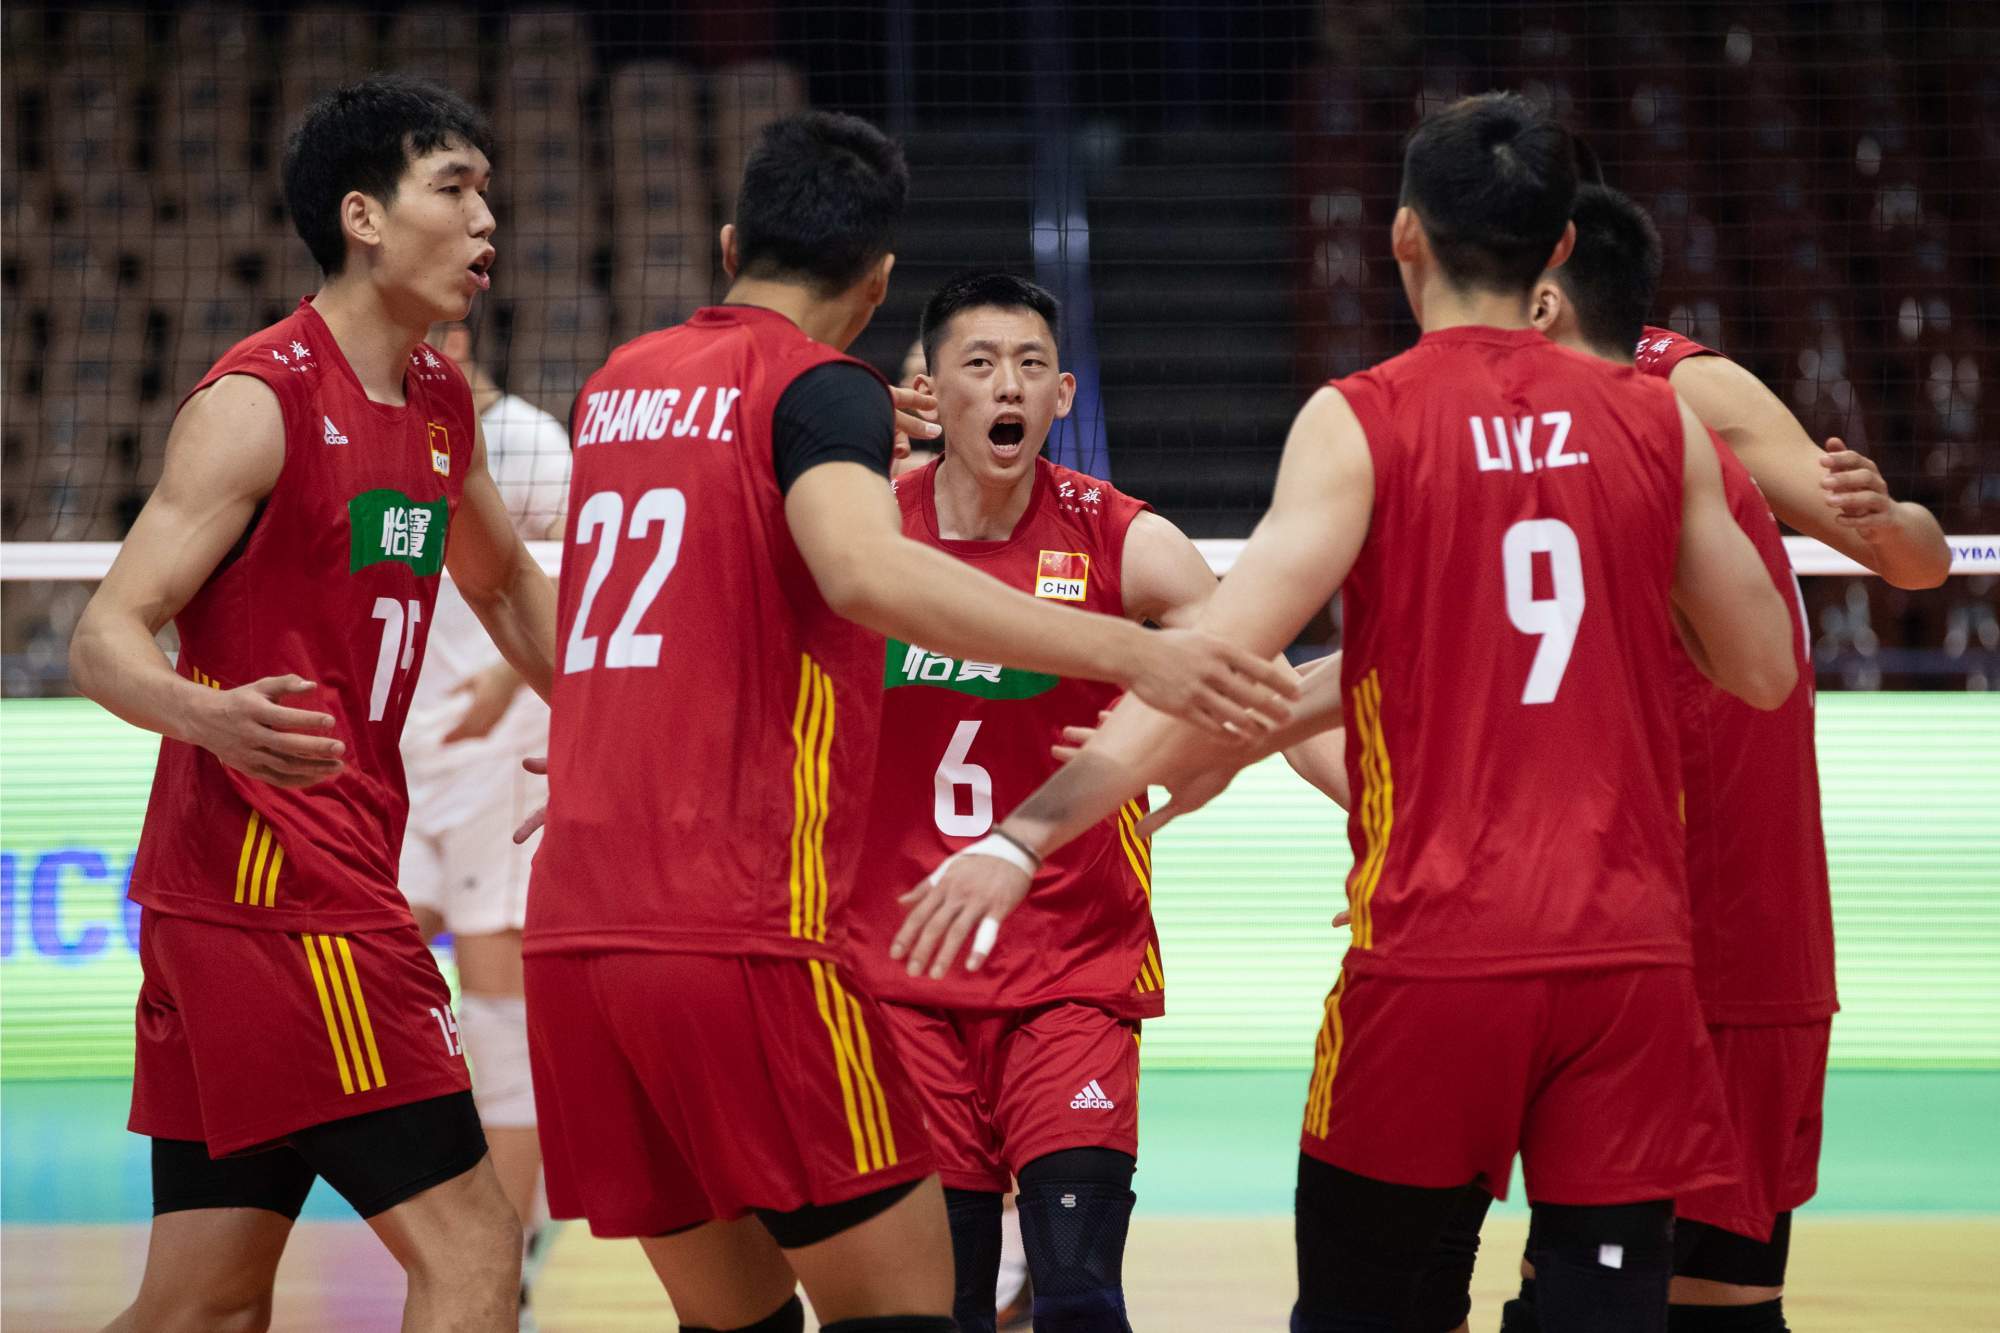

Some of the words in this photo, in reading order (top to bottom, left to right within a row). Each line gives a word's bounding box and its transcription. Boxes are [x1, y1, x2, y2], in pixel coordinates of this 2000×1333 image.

[578, 387, 681, 448] ZHANG
[671, 386, 707, 438] J.
[707, 387, 741, 442] Y.
[564, 487, 687, 675] 22
[1952, 547, 2000, 560] YBA
[1043, 582, 1080, 596] CHN
[1502, 518, 1586, 705] 9
[934, 720, 993, 838] 6
[1070, 1098, 1114, 1110] adidas
